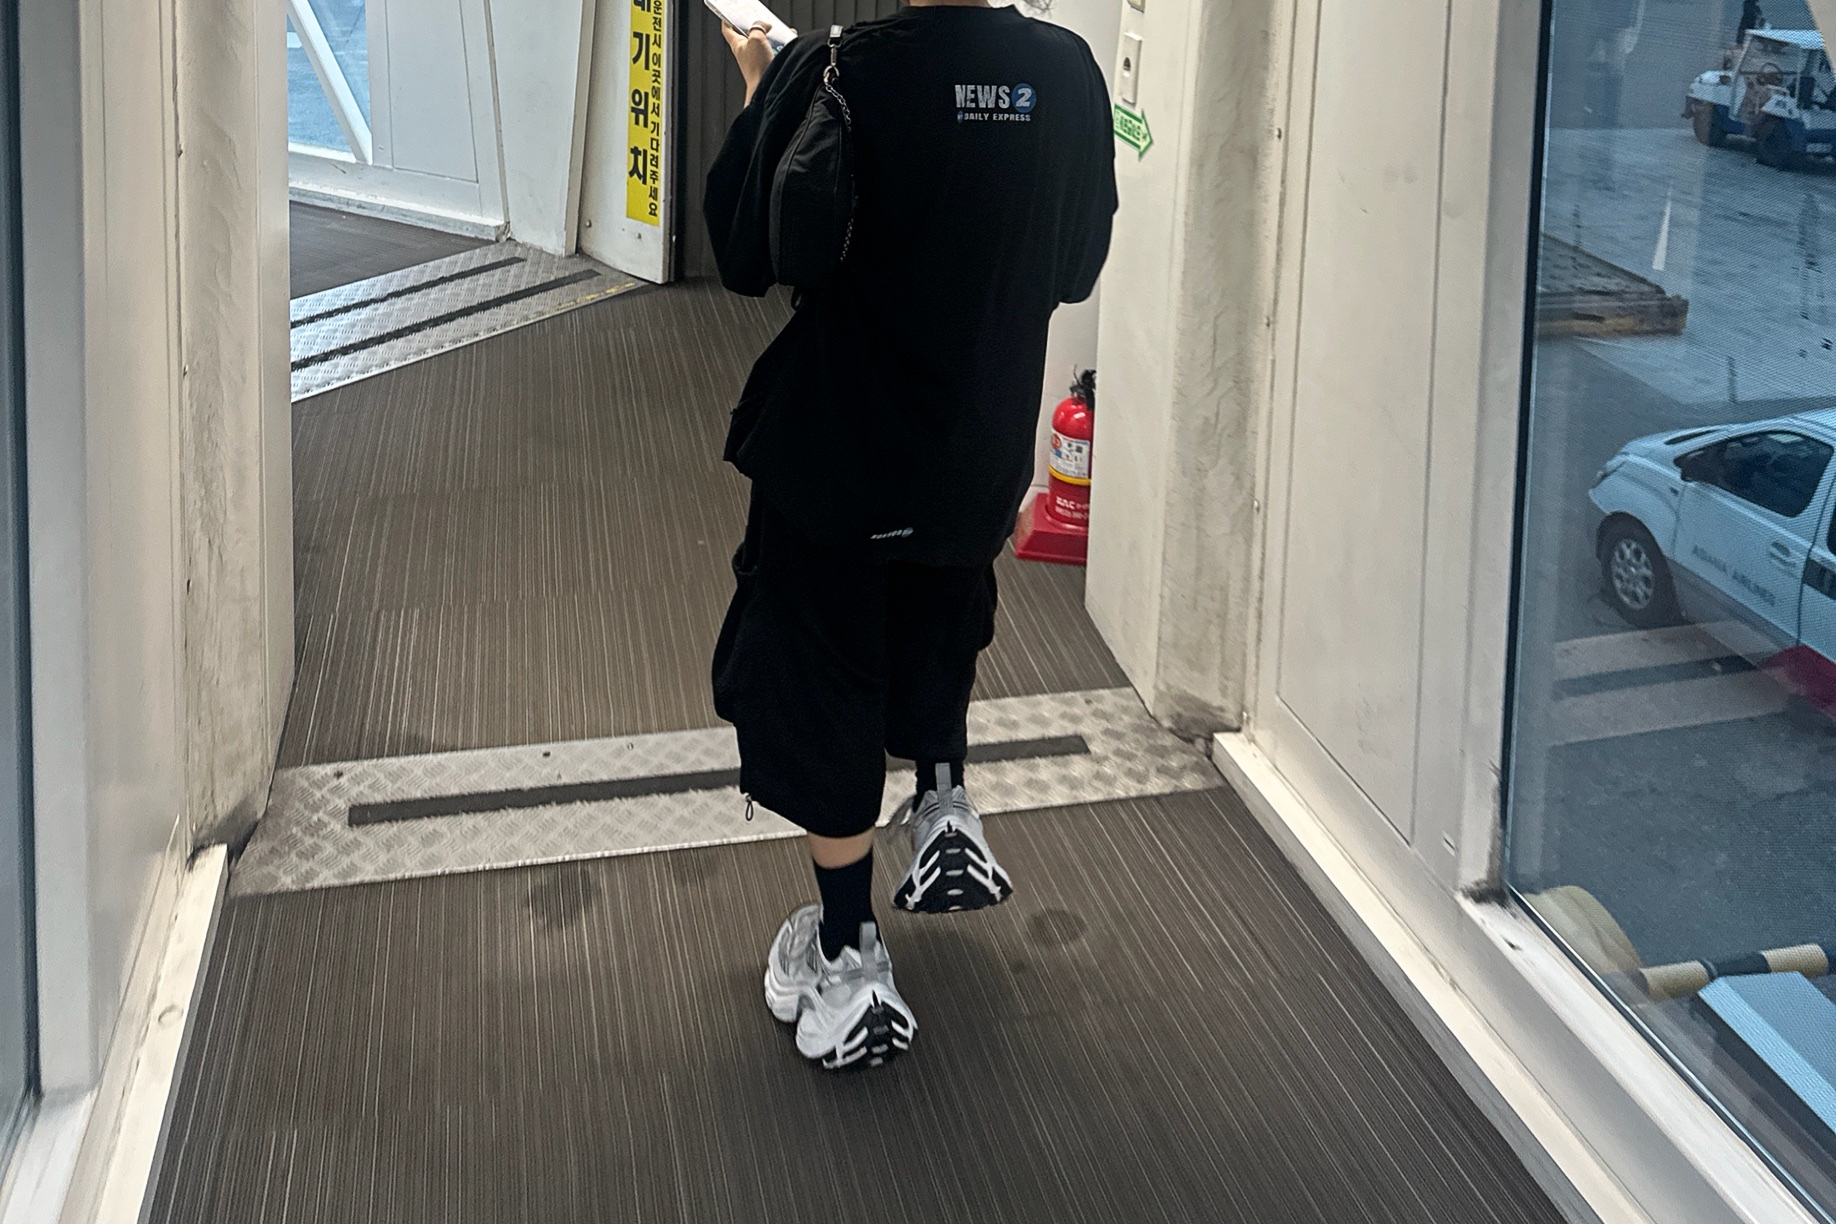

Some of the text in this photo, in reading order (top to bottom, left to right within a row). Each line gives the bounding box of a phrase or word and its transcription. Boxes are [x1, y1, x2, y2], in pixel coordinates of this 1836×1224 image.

[651, 0, 663, 50] 운전시
[650, 52, 662, 118] 이곳에서
[954, 84, 1033, 109] NEWS 2
[963, 112, 1031, 122] DAILY EXPRESS
